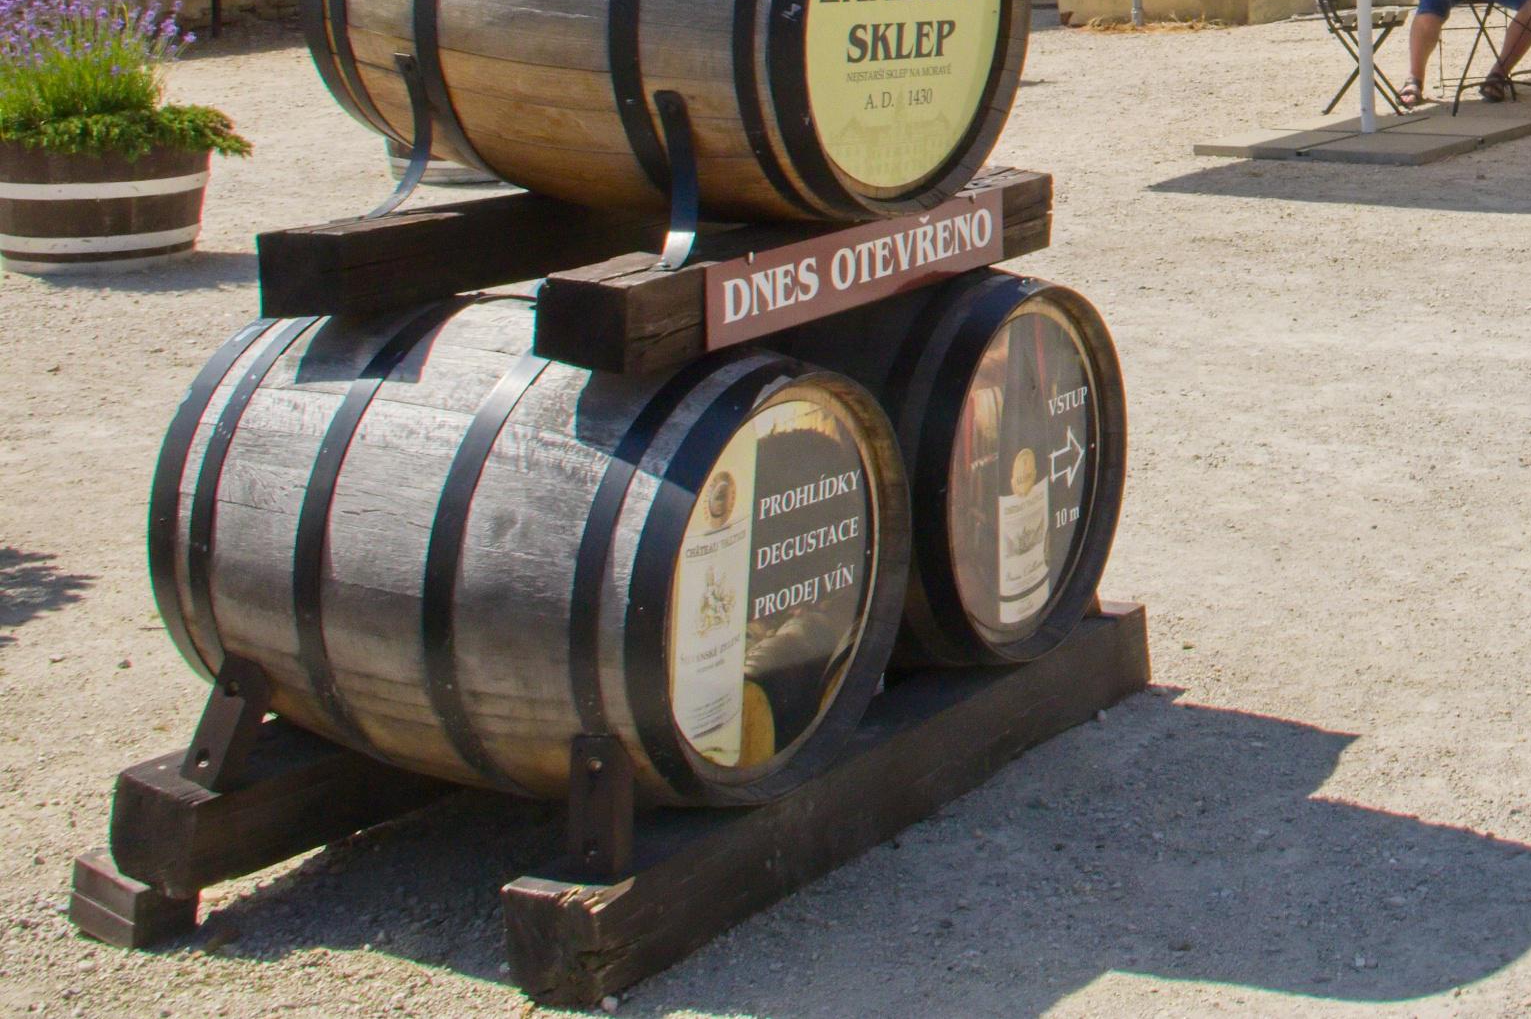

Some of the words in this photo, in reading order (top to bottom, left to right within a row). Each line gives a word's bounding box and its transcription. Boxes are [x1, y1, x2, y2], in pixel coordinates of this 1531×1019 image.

[847, 19, 957, 63] SKLEP
[908, 87, 934, 107] 1430
[722, 256, 820, 324] DNES
[830, 208, 993, 292] OTEVŘENO
[1048, 385, 1088, 417] VSTUP
[759, 469, 862, 521] PROHLÍDKY
[1055, 507, 1068, 529] 10
[1069, 505, 1081, 522] m
[756, 515, 860, 570] DEGUSTACE
[754, 575, 820, 620] PRODEJ
[823, 562, 855, 594] VÍN
